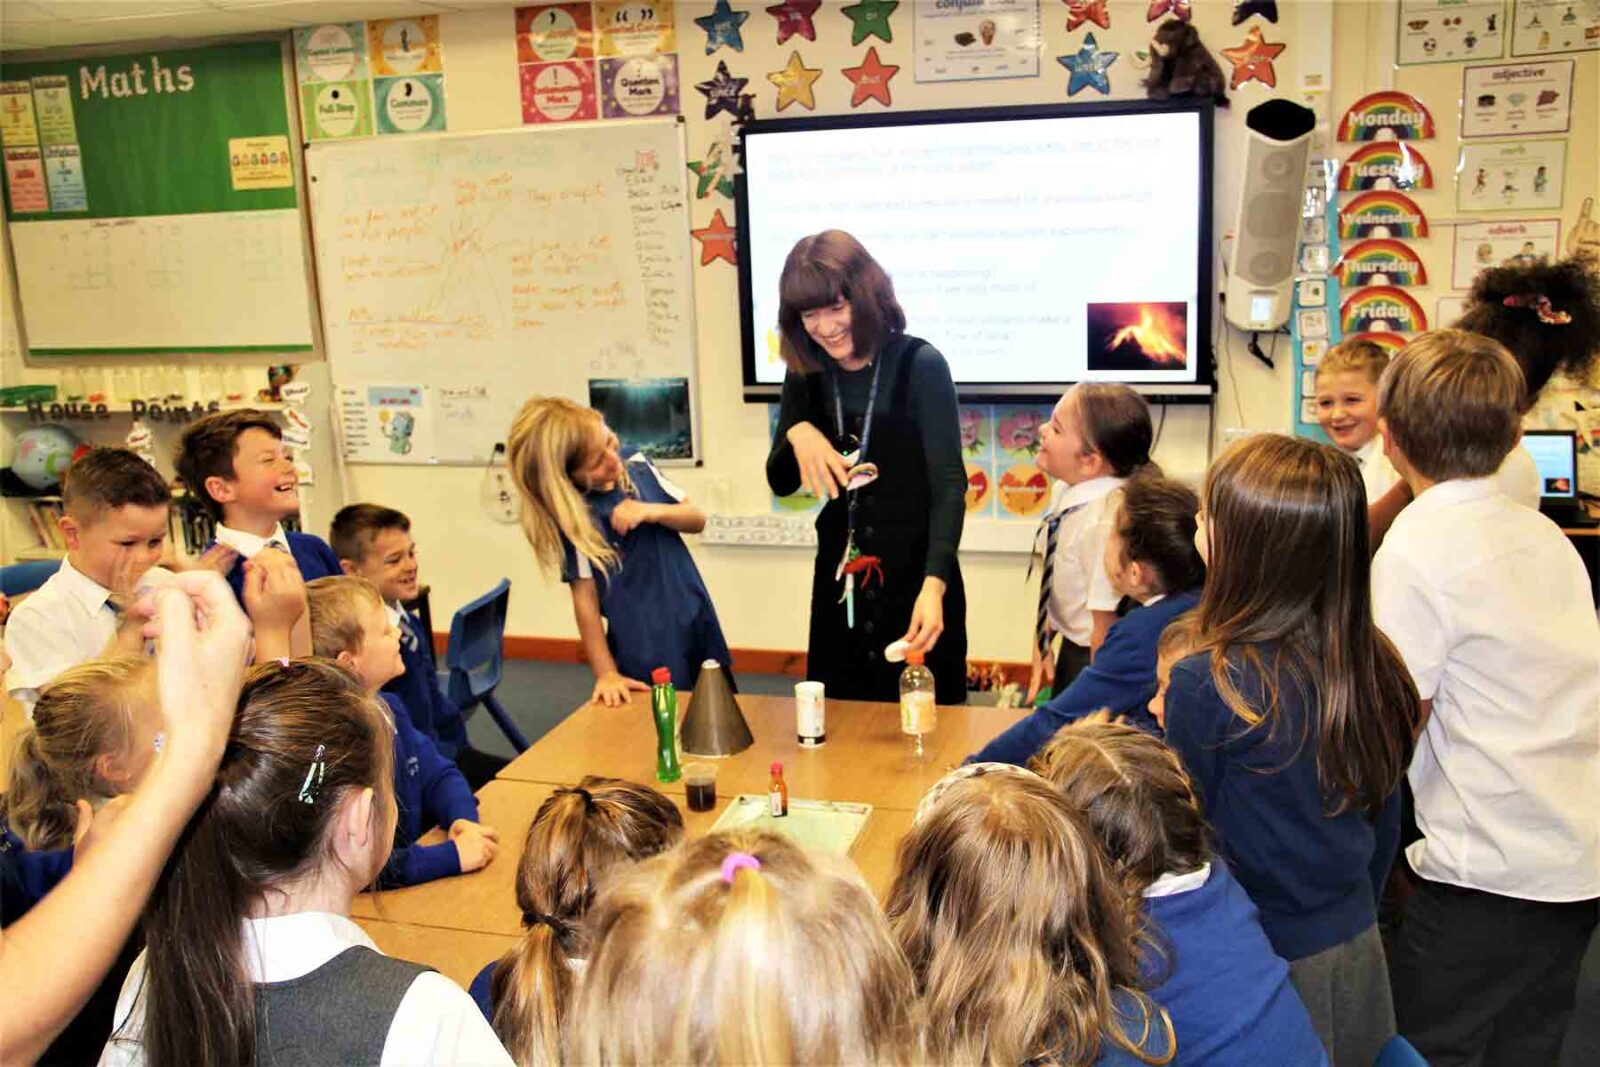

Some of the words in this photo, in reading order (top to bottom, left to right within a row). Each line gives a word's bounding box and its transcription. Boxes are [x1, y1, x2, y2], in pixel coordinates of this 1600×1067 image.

[79, 57, 195, 100] Maths
[1492, 69, 1546, 81] adjective
[621, 78, 660, 88] Question
[546, 94, 569, 104] Mark
[629, 87, 652, 96] Mark
[1348, 109, 1426, 129] Monday
[1346, 160, 1424, 182] Tuesdy
[1342, 211, 1420, 226] Wednesday
[1488, 225, 1527, 235] adverb
[1342, 259, 1419, 274] Thursday
[1350, 301, 1409, 322] Friday
[28, 400, 110, 422] House
[131, 399, 220, 423] Points
